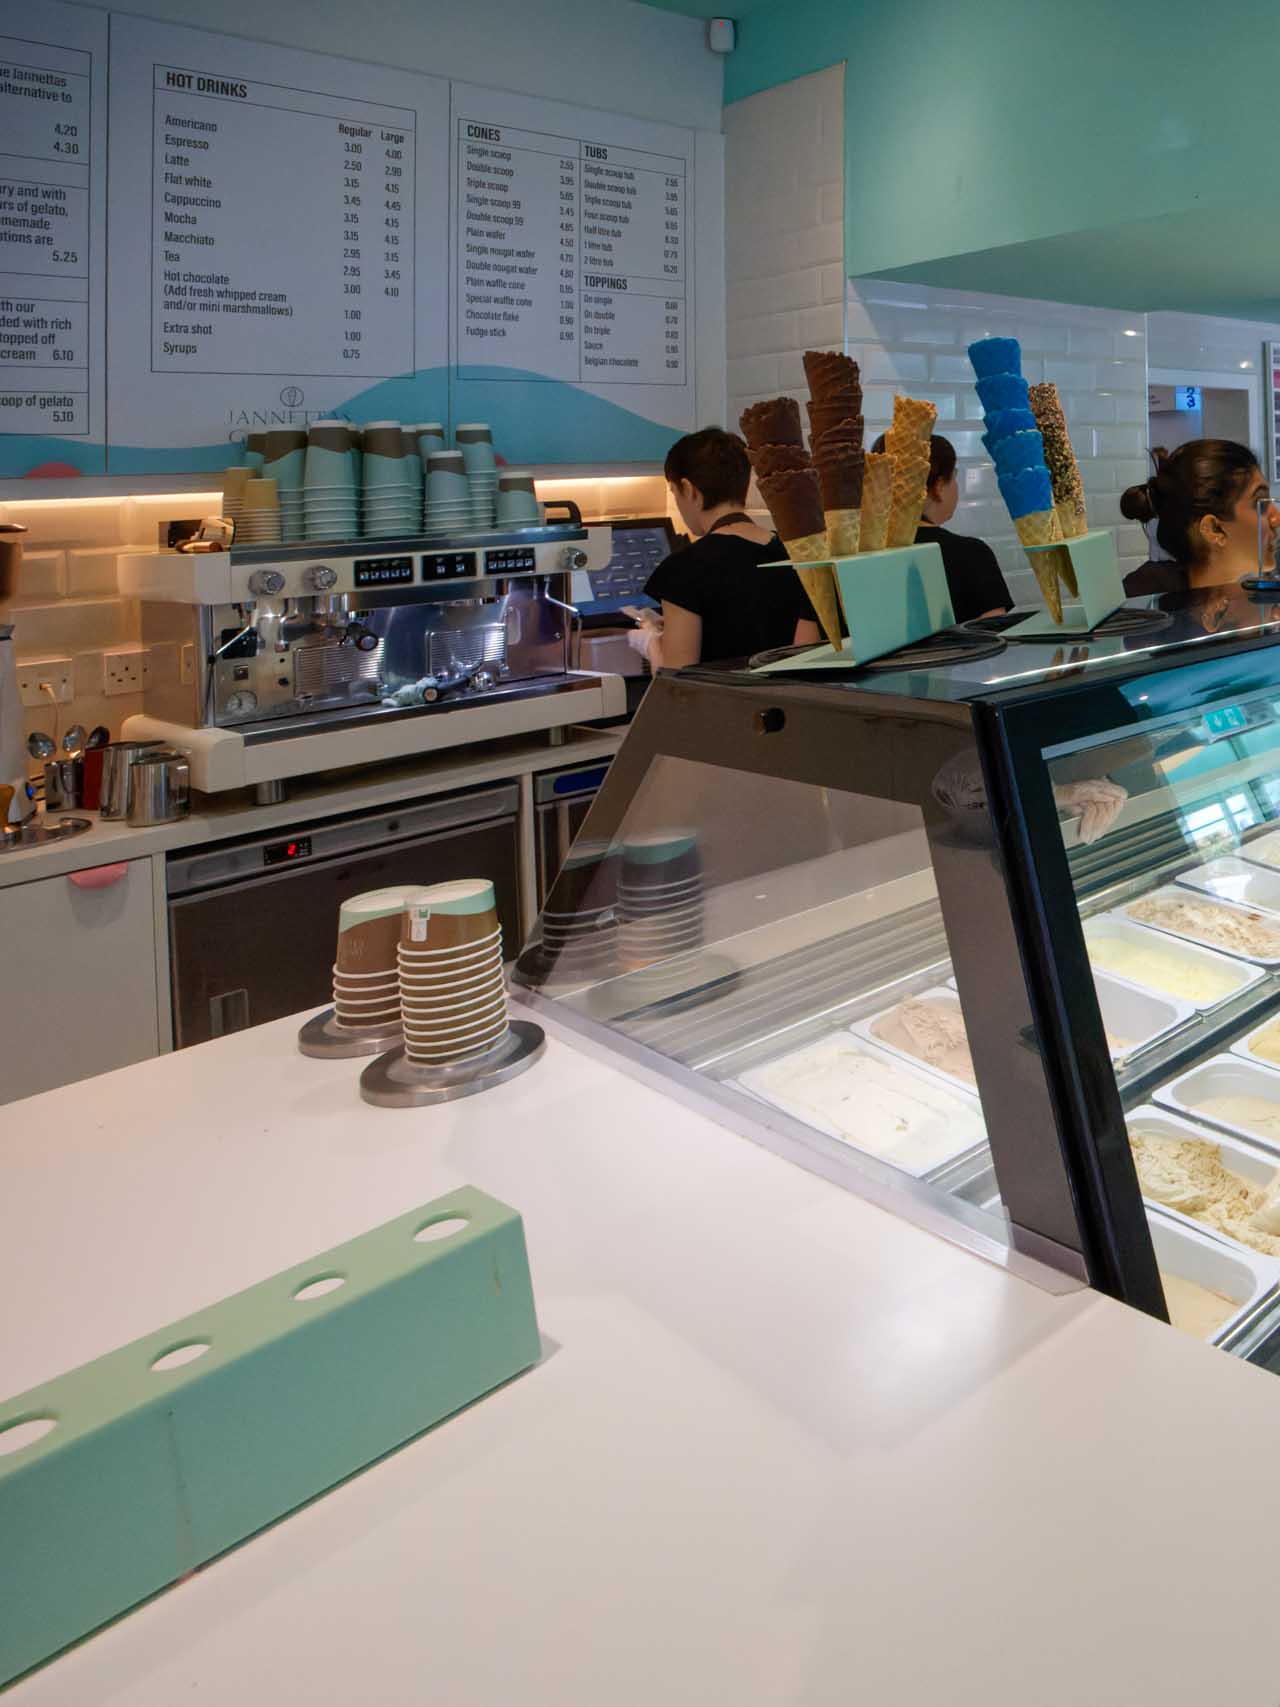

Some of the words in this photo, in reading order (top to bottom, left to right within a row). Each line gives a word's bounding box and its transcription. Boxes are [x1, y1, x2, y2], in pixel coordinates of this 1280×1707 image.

[166, 72, 194, 88] HOT
[197, 77, 248, 98] DRINKS
[61, 92, 73, 103] to
[165, 114, 218, 132] Americano
[54, 123, 77, 137] 4.20
[339, 123, 372, 138] Regular
[380, 130, 404, 144] Large
[467, 124, 501, 142] CONES
[53, 140, 79, 155] 4.30
[165, 134, 209, 150] Espresso
[344, 142, 362, 154] 3.00
[585, 145, 608, 160] TUBS
[165, 153, 190, 166] Latte
[165, 172, 182, 185] Flat
[184, 175, 212, 188] white
[17, 186, 39, 198] and
[41, 188, 66, 201] with
[385, 184, 399, 194] 4.15
[17, 200, 28, 212] of
[165, 192, 222, 208] Cappuccino
[165, 211, 197, 224] Mocha
[344, 213, 359, 224] 3.15
[35, 235, 53, 246] are
[165, 231, 215, 246] Macchiato
[344, 230, 359, 241] 3.15
[52, 250, 78, 263] 5.25
[164, 250, 180, 262] Tea
[164, 271, 180, 282] Hot
[183, 272, 230, 285] chocolate
[584, 275, 628, 290] TOPPINGS
[164, 284, 187, 297] (Add
[190, 285, 214, 298] fresh
[216, 288, 256, 301] whipped
[259, 293, 287, 303] cream
[344, 284, 361, 294] 3.00
[16, 303, 35, 313] our
[164, 299, 197, 311] and/or
[200, 301, 220, 312] mini
[223, 303, 293, 317] marshmallows)
[23, 317, 48, 329] with
[51, 318, 71, 330] rich
[163, 322, 189, 334] Extra
[191, 323, 212, 335] shot
[41, 333, 56, 345] off
[0, 349, 36, 361] cream
[52, 349, 74, 361] 6.10
[163, 342, 197, 355] Syrups
[343, 349, 360, 359] 0.75
[25, 394, 36, 407] of
[39, 396, 74, 409] gelato
[52, 411, 74, 422] 5.10
